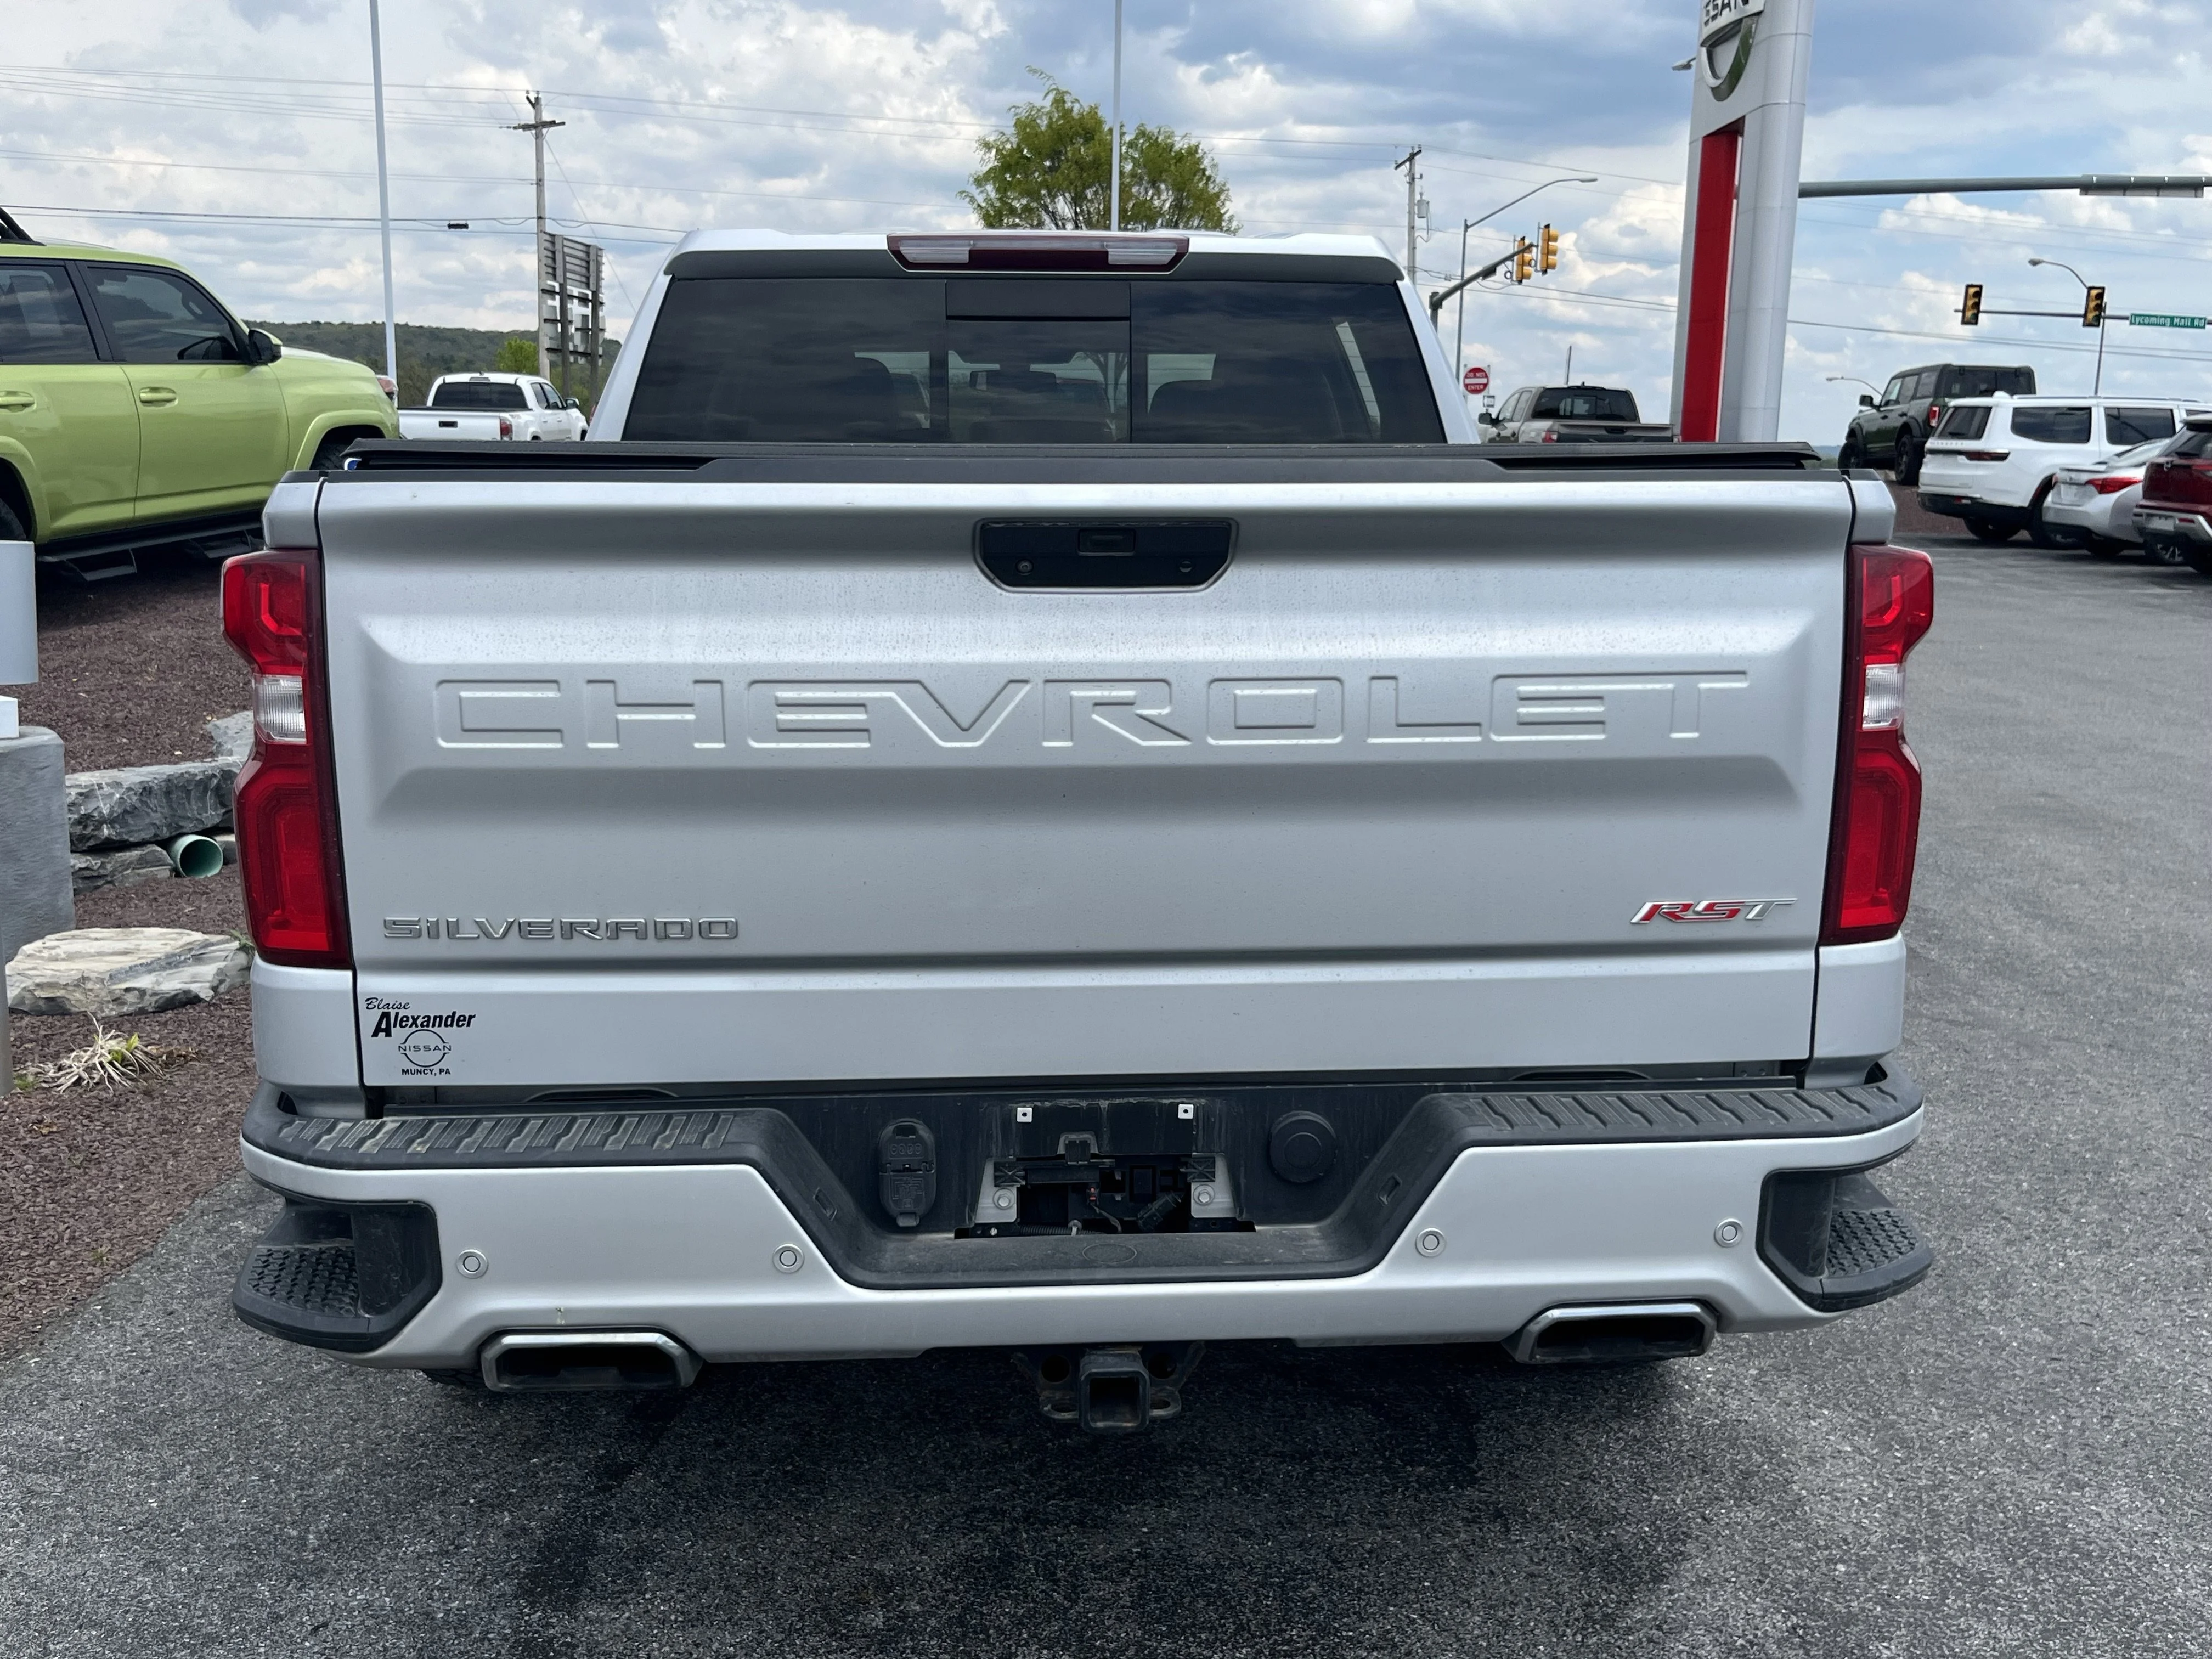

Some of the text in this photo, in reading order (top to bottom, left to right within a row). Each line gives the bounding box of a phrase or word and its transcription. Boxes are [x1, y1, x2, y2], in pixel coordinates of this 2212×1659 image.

[2131, 315, 2205, 327] Lycoming Mall Rd
[434, 670, 1750, 748] CHEVROLET
[1630, 898, 1798, 923] RST
[383, 917, 739, 940] SILVERADO
[365, 997, 411, 1010] Blaise
[371, 1011, 476, 1037] Alexander
